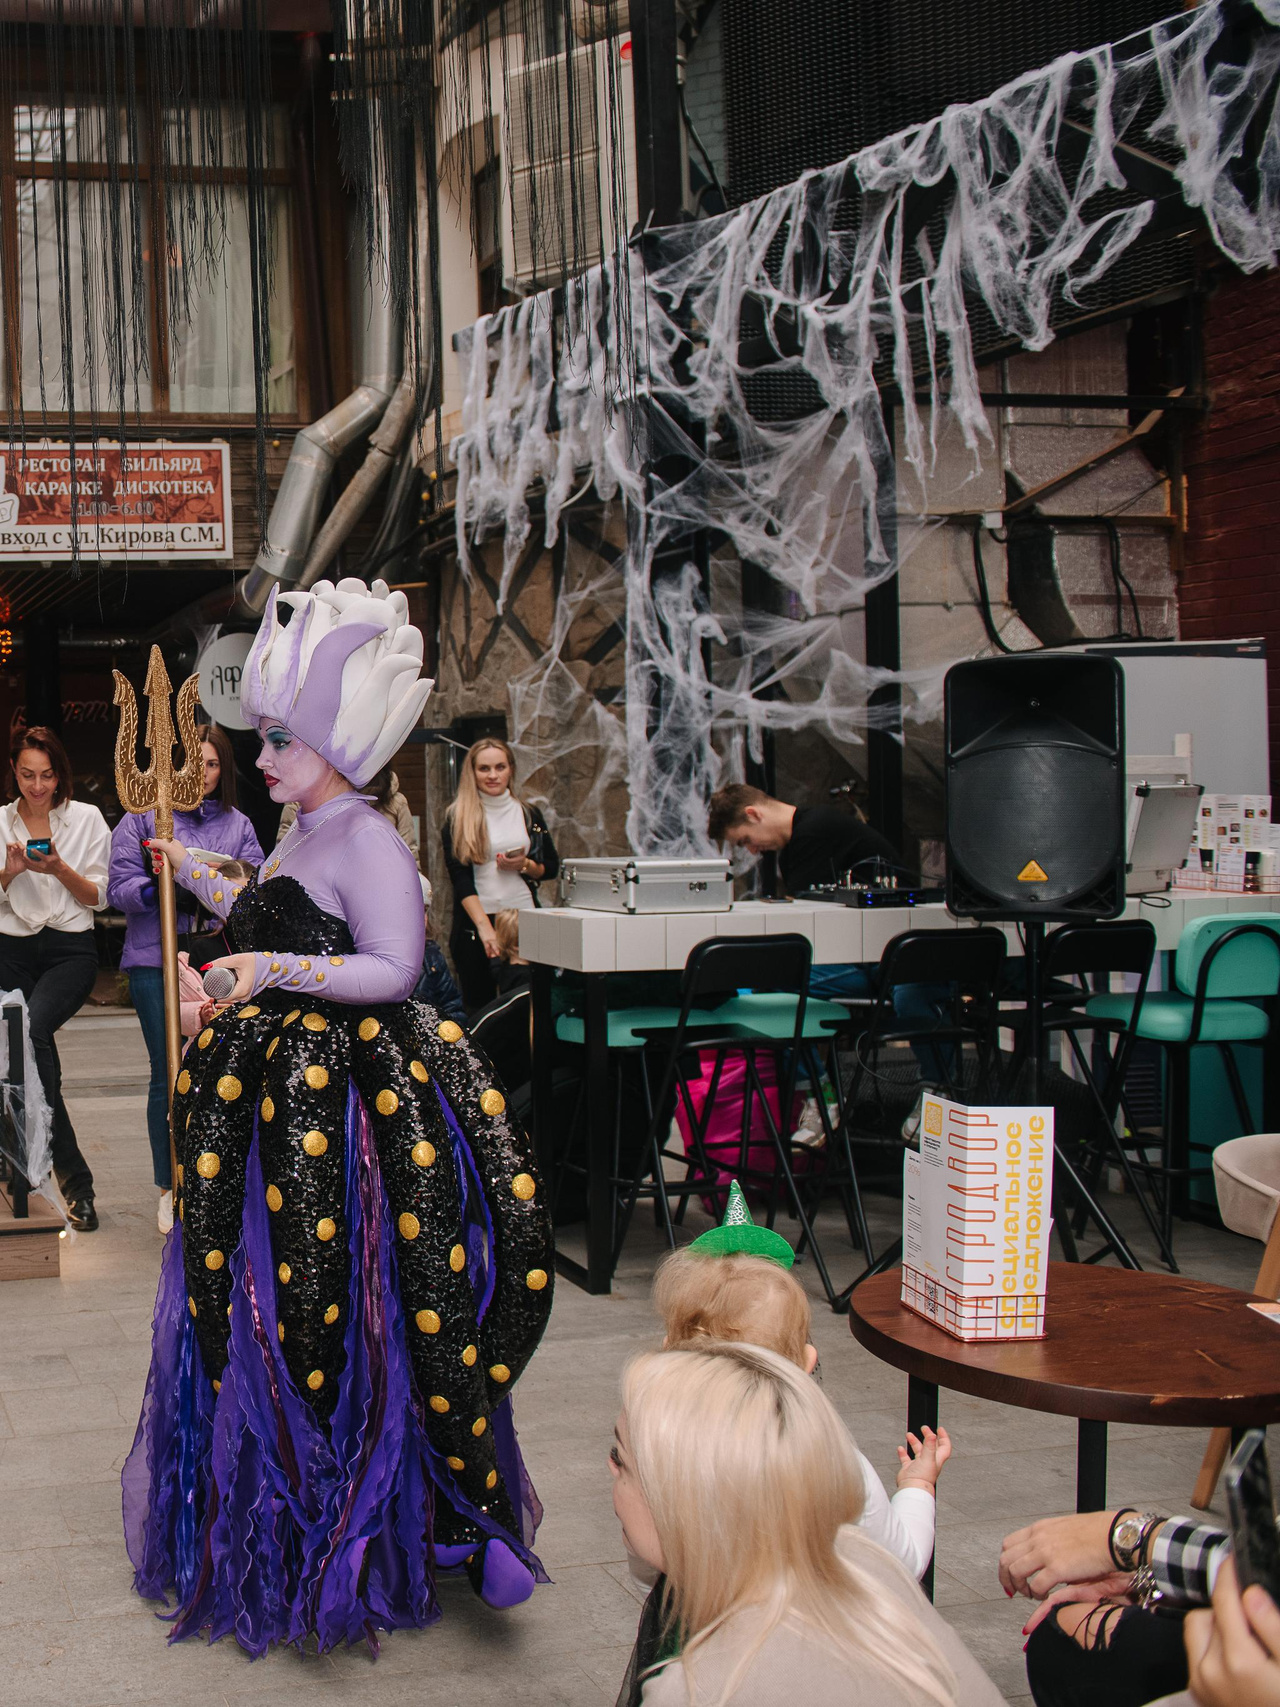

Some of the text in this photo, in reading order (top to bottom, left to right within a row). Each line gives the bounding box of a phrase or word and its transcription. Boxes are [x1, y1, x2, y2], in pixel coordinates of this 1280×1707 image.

[17, 457, 202, 474] РЕСТОРАН БИЛЬЯРД
[113, 480, 215, 496] ДИСКОТЕКА
[1, 532, 48, 547] вход
[53, 532, 62, 544] с
[100, 527, 175, 548] Кирова
[180, 526, 219, 543] С.М.
[945, 1108, 999, 1331] ГАСТРОДВОР
[1000, 1122, 1022, 1329] специальное
[1021, 1115, 1044, 1329] предложение
